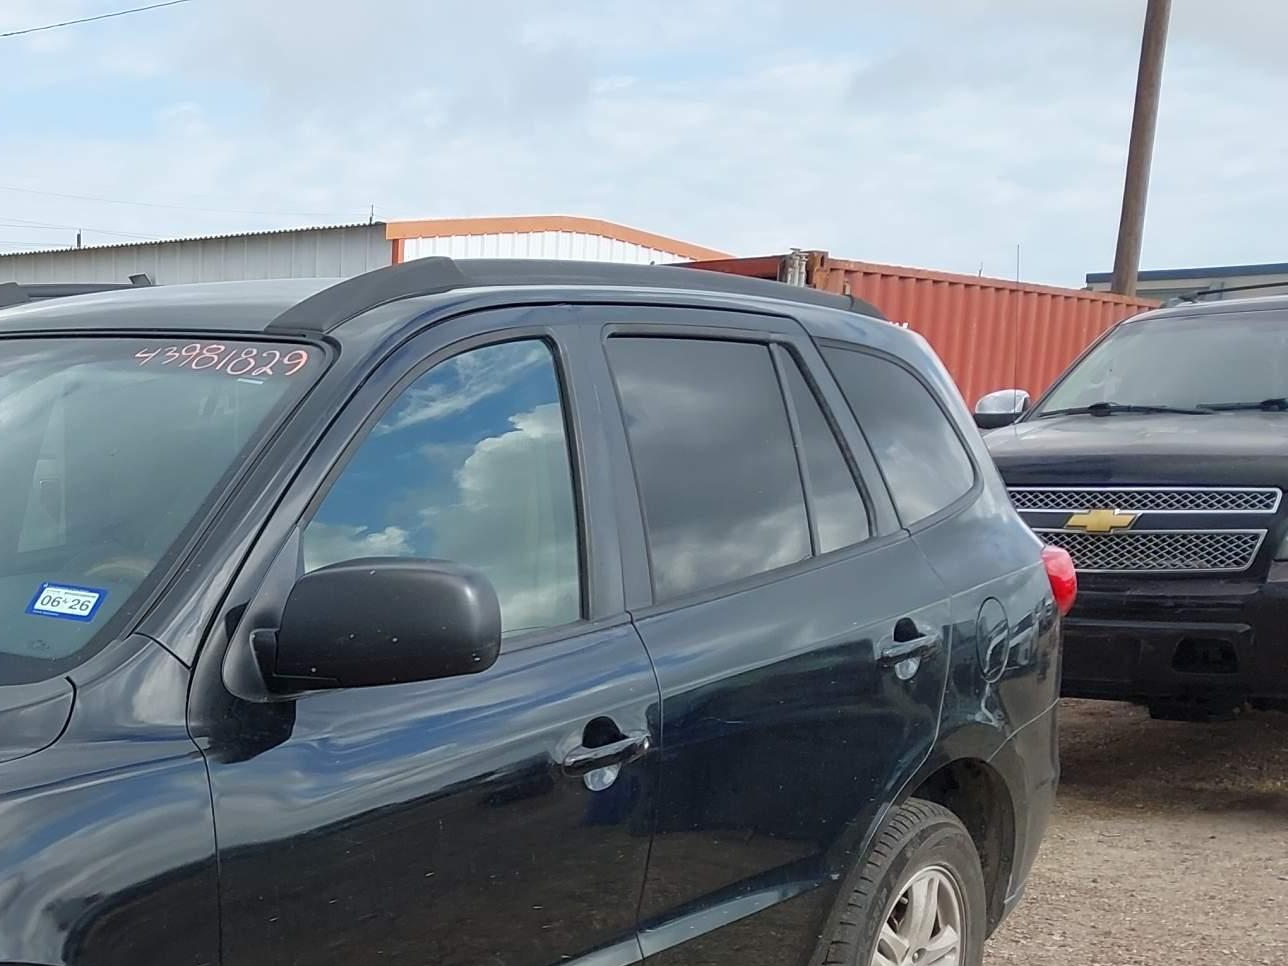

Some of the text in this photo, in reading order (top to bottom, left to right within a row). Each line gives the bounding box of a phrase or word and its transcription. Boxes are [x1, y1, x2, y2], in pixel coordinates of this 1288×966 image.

[134, 343, 309, 377] 43981829
[40, 594, 63, 608] 06
[68, 598, 92, 612] 26
